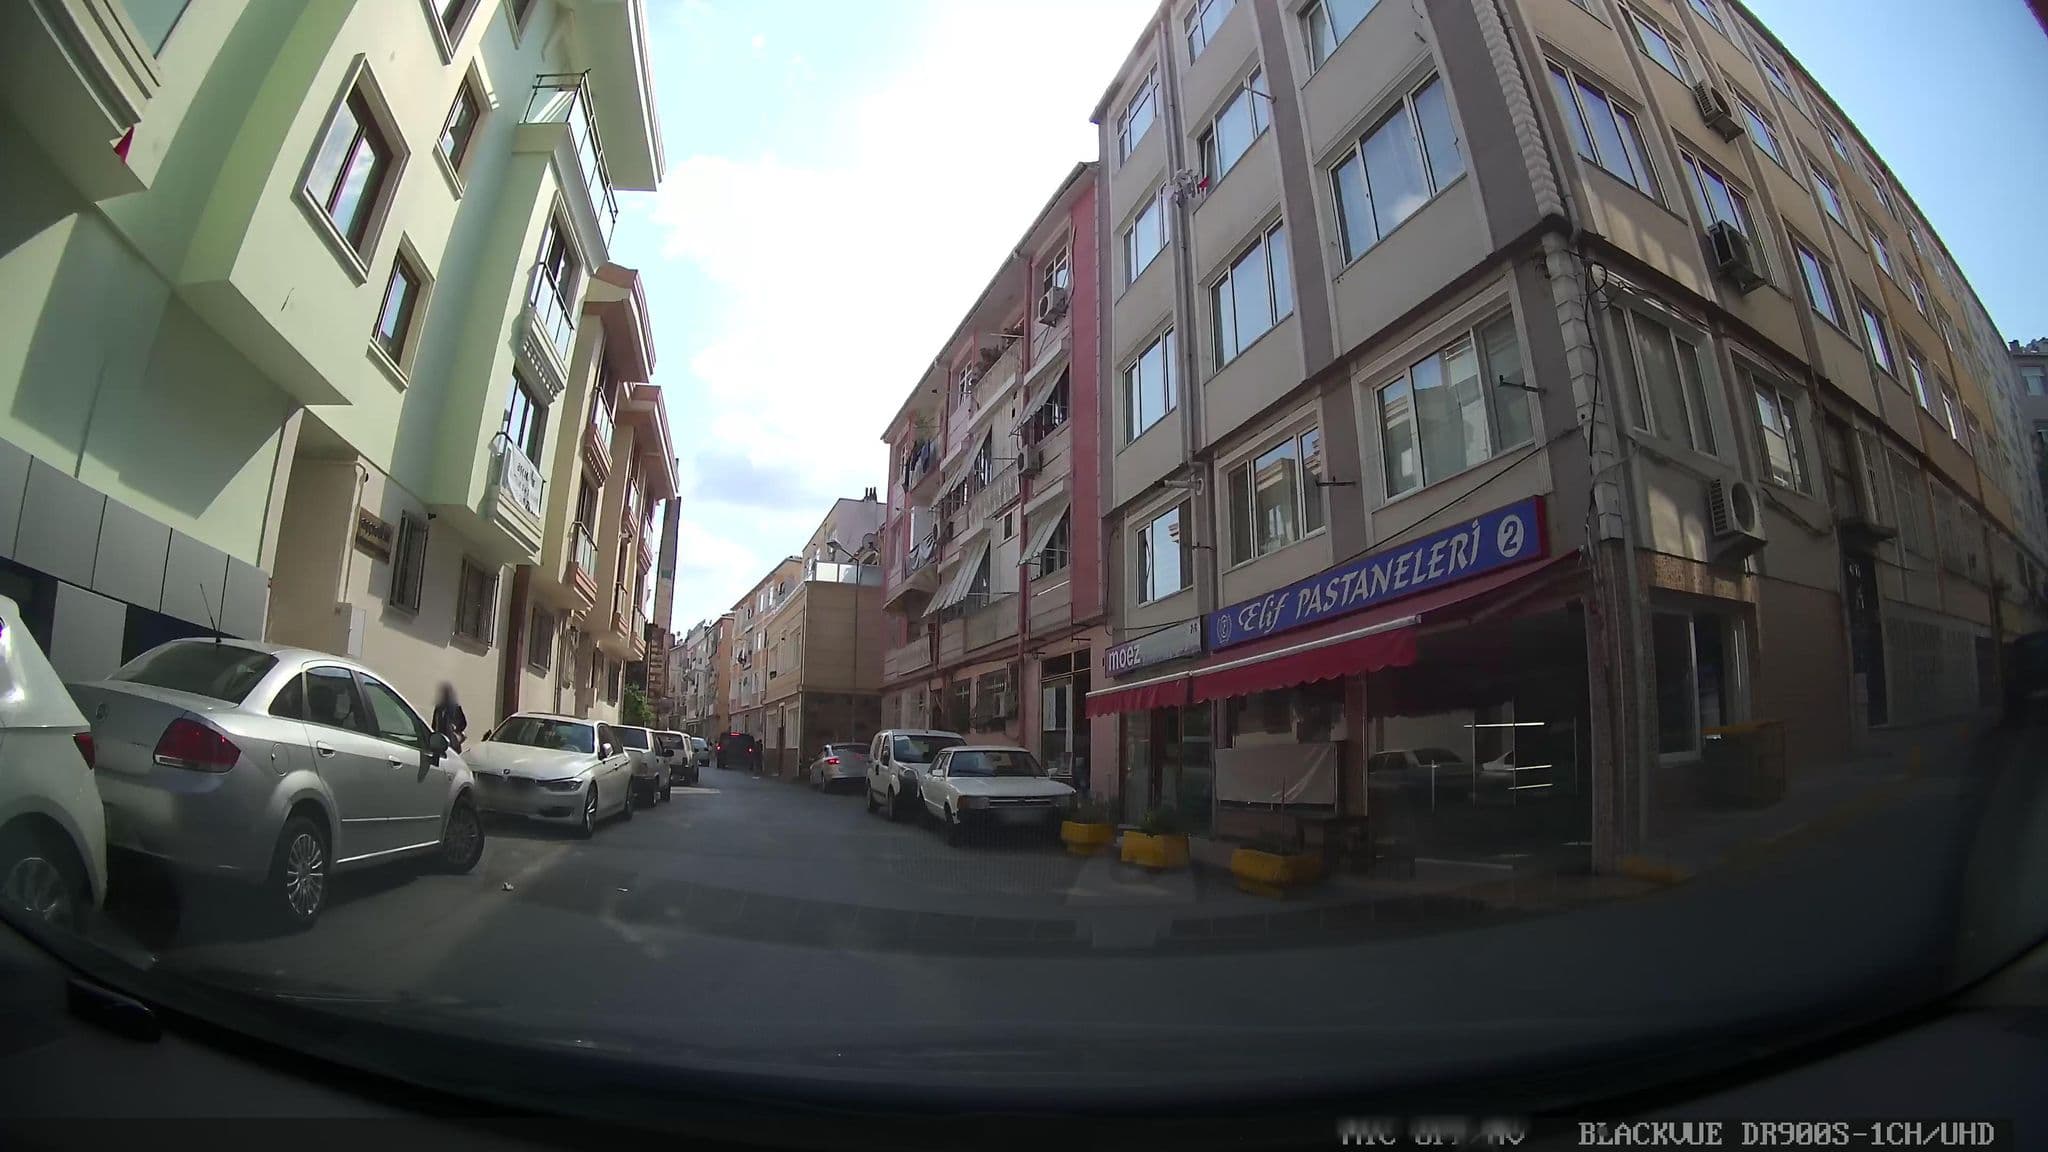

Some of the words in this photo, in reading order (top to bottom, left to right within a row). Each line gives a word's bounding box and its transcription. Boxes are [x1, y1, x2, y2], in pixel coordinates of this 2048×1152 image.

[1238, 593, 1288, 633] Elif
[1296, 518, 1480, 620] PASTANELERİ
[1108, 643, 1141, 671] moez
